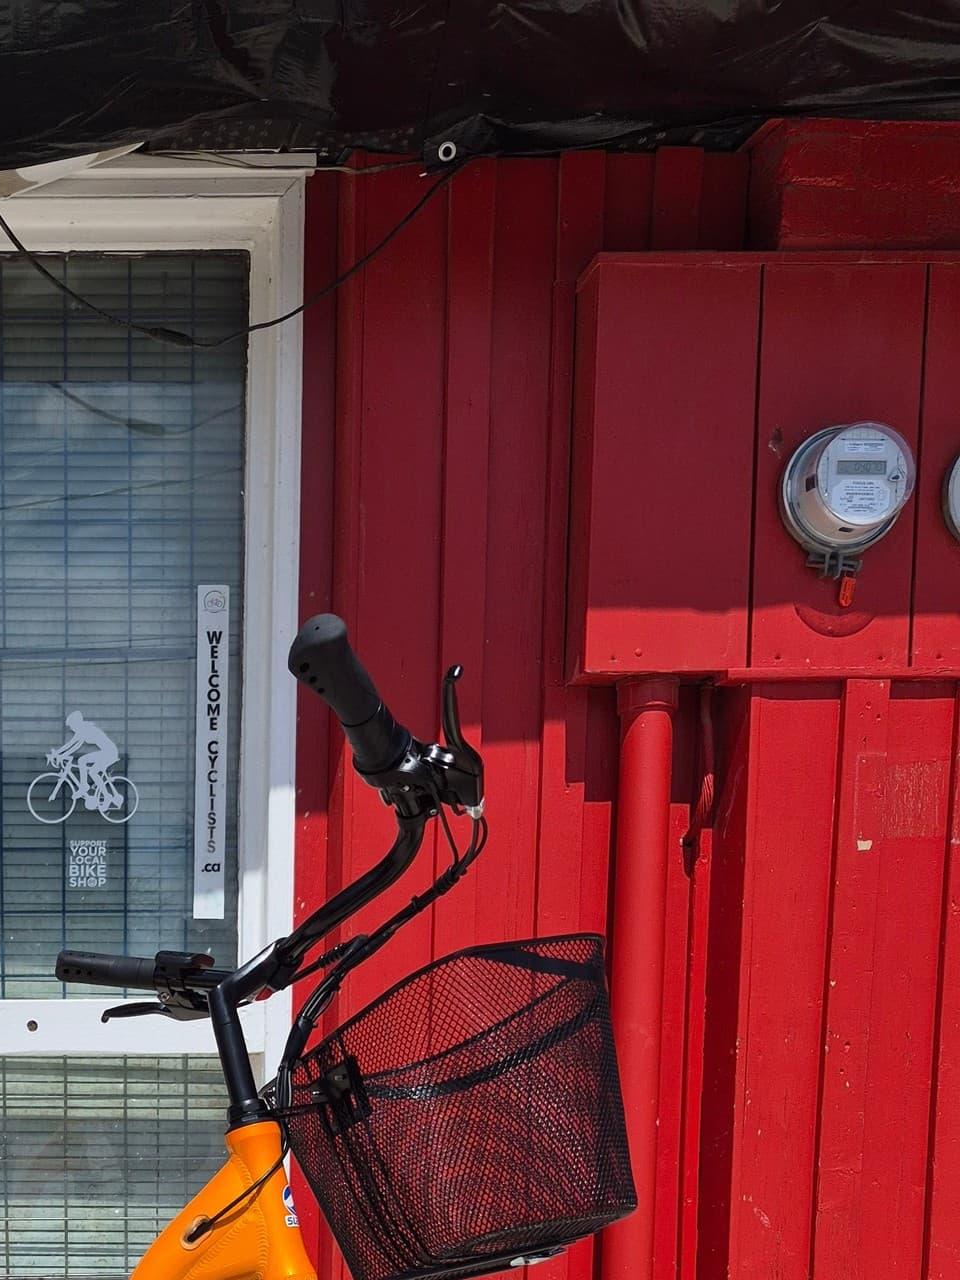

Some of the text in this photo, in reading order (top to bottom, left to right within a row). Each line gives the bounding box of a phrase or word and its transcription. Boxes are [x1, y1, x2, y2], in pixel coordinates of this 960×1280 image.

[206, 630, 223, 731] WELCOME
[206, 740, 220, 853] CYCLISTS
[70, 846, 106, 857] YOUR
[70, 856, 106, 865] LOCAL
[69, 864, 107, 877] BIKE
[201, 862, 221, 873] .ca
[69, 877, 106, 888] SHOP
